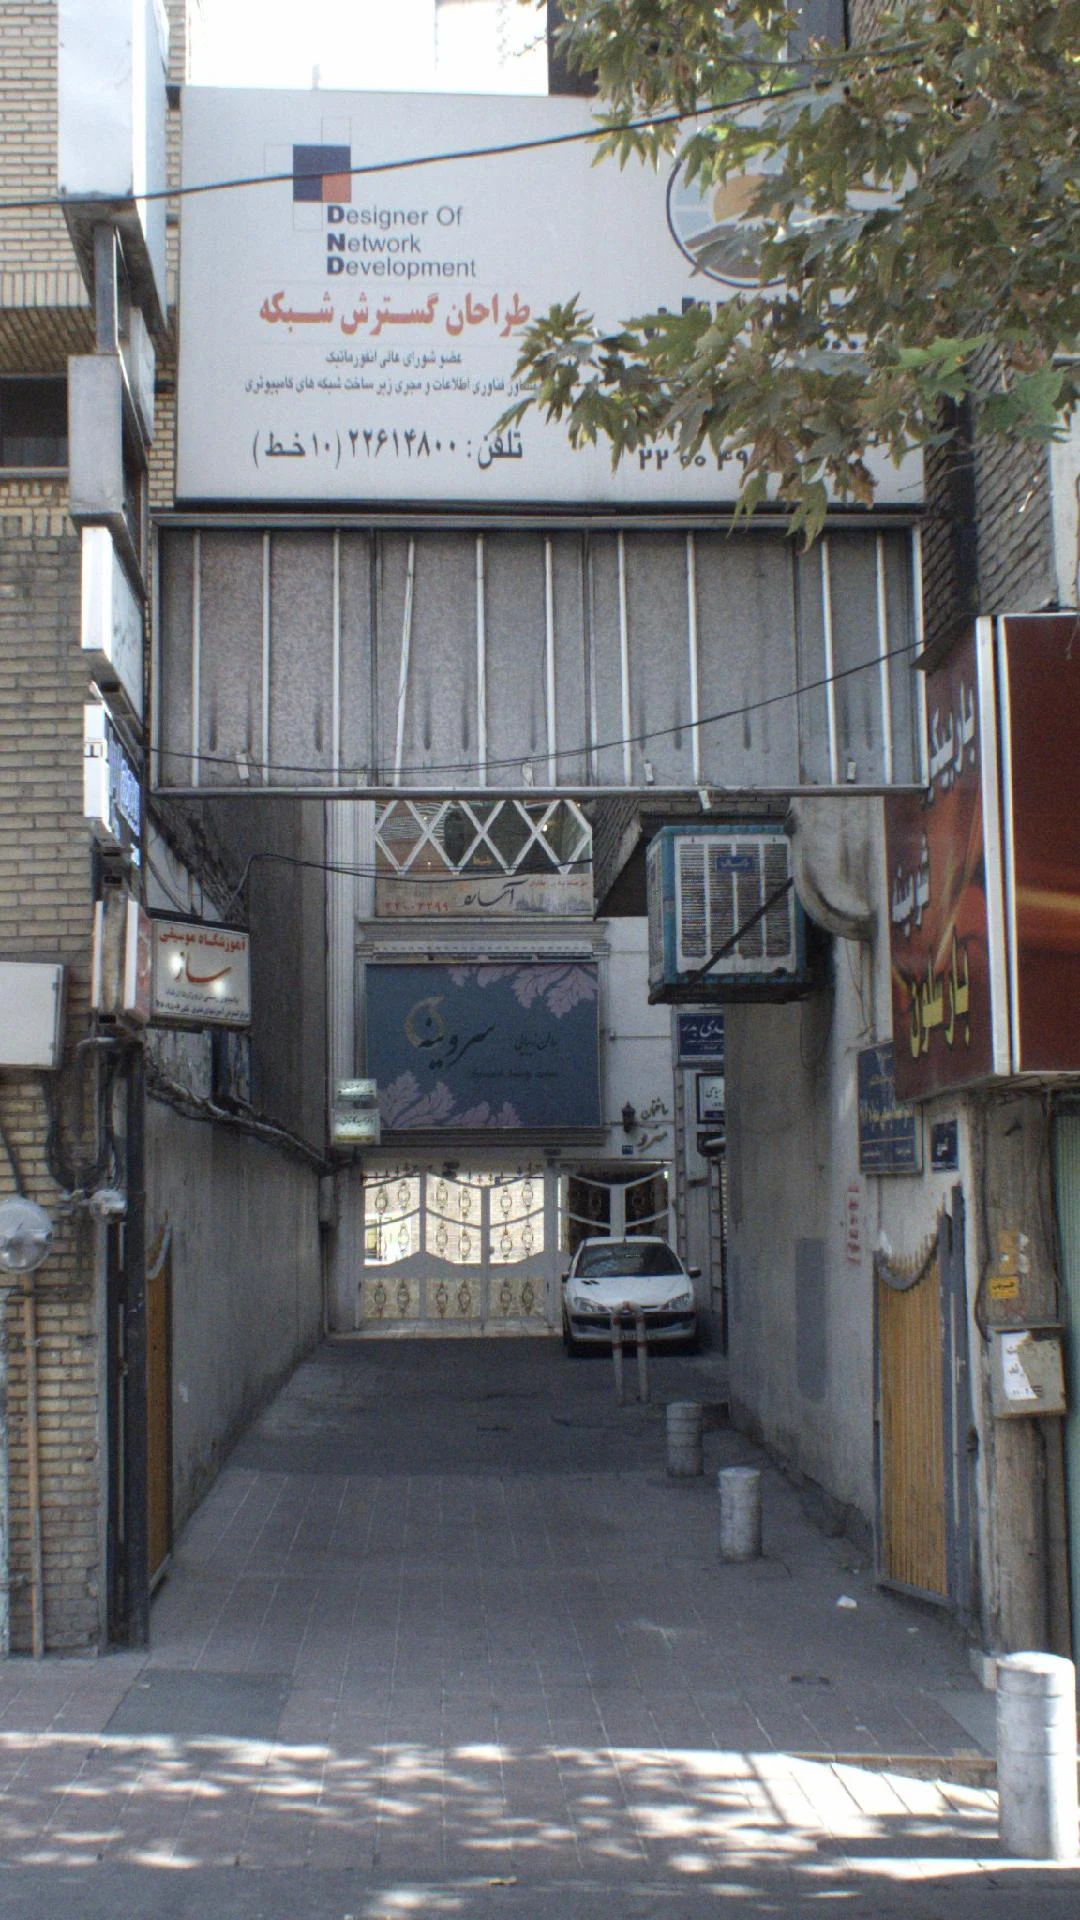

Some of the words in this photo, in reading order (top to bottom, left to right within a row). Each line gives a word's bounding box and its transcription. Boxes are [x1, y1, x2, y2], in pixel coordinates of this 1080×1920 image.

[327, 204, 429, 230] Designer
[437, 206, 463, 226] Of
[327, 232, 422, 253] Network
[327, 255, 477, 280] Development
[259, 289, 334, 333] شبکه
[340, 291, 439, 337] گسترش
[446, 291, 531, 338] طراحان
[325, 350, 377, 369] انفورماتیک
[403, 350, 436, 369] شورای
[438, 351, 462, 369] عضو
[245, 375, 294, 395] کامپیوتری
[295, 375, 315, 394] های
[318, 375, 341, 395] شبکه
[395, 380, 422, 396] مجری
[432, 375, 470, 391] اطلاعات
[349, 428, 456, 459] ۲۲۶۱۴۸۰۰
[198, 933, 246, 953] آموزشگاه
